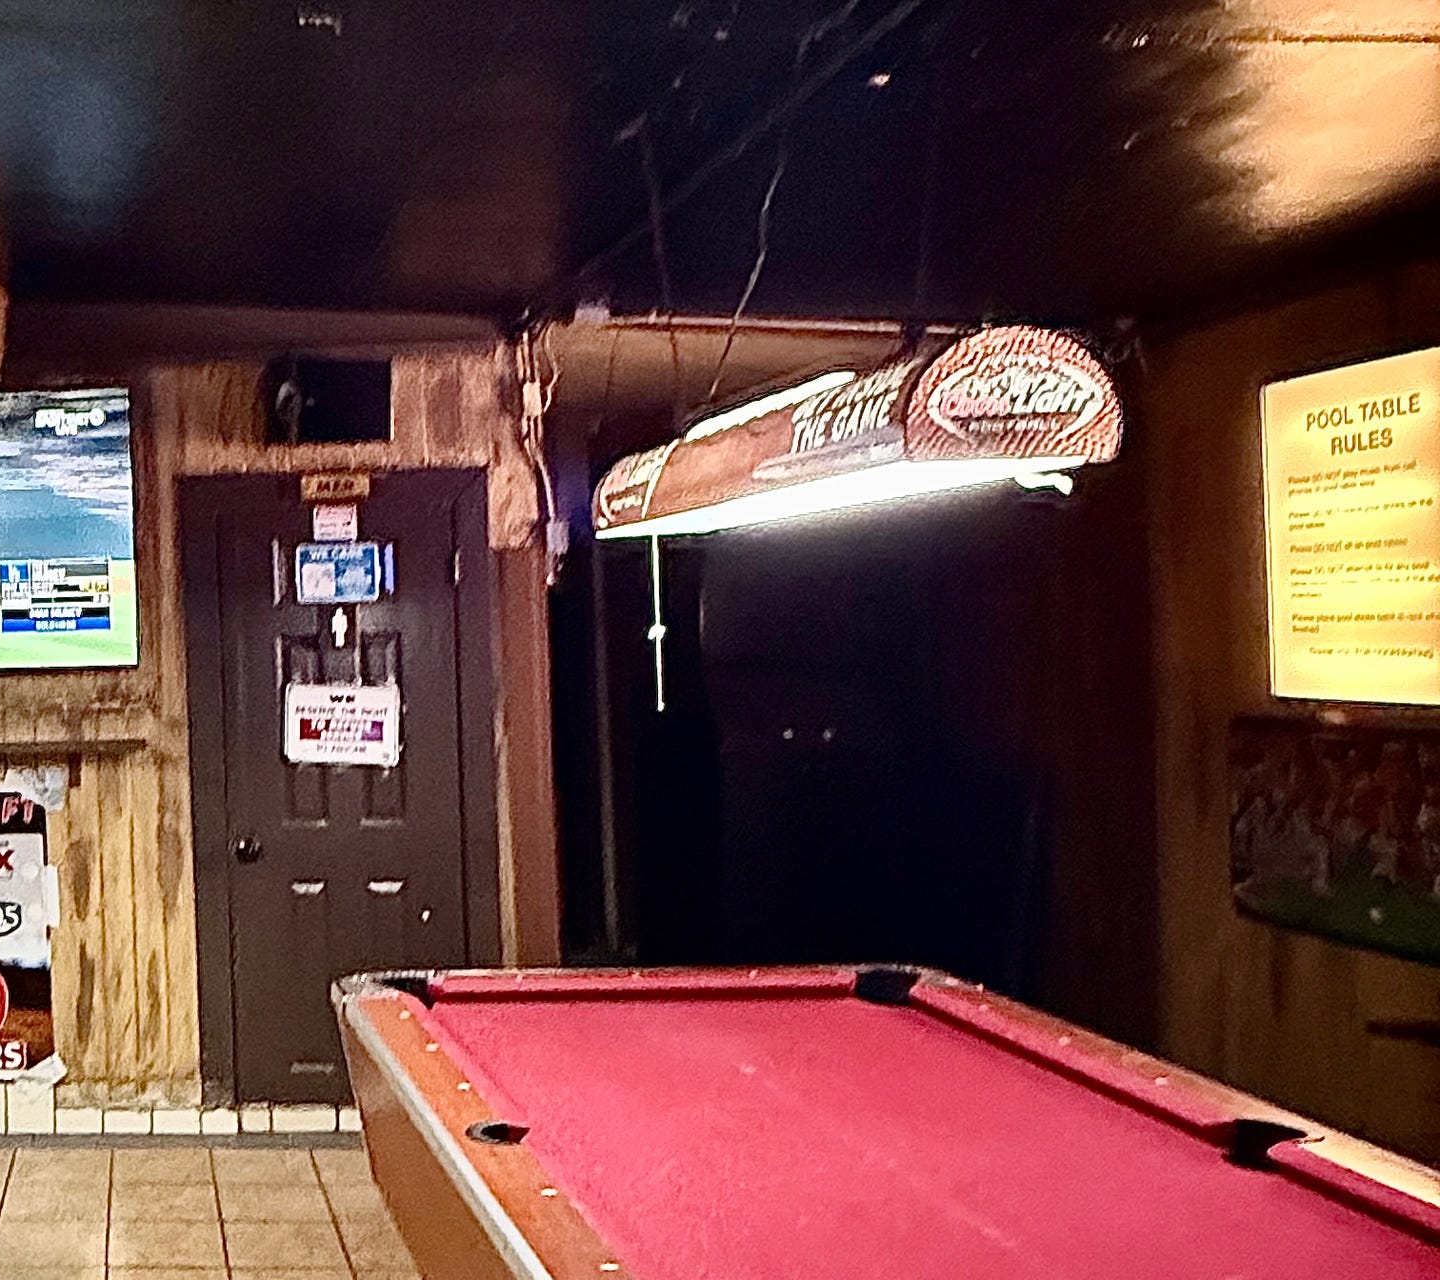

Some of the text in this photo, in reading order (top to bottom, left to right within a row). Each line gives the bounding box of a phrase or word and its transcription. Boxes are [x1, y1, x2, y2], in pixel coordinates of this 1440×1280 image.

[789, 390, 900, 455] THE GAME
[1306, 392, 1421, 432] POOL TABLE
[1331, 427, 1393, 457] RULES
